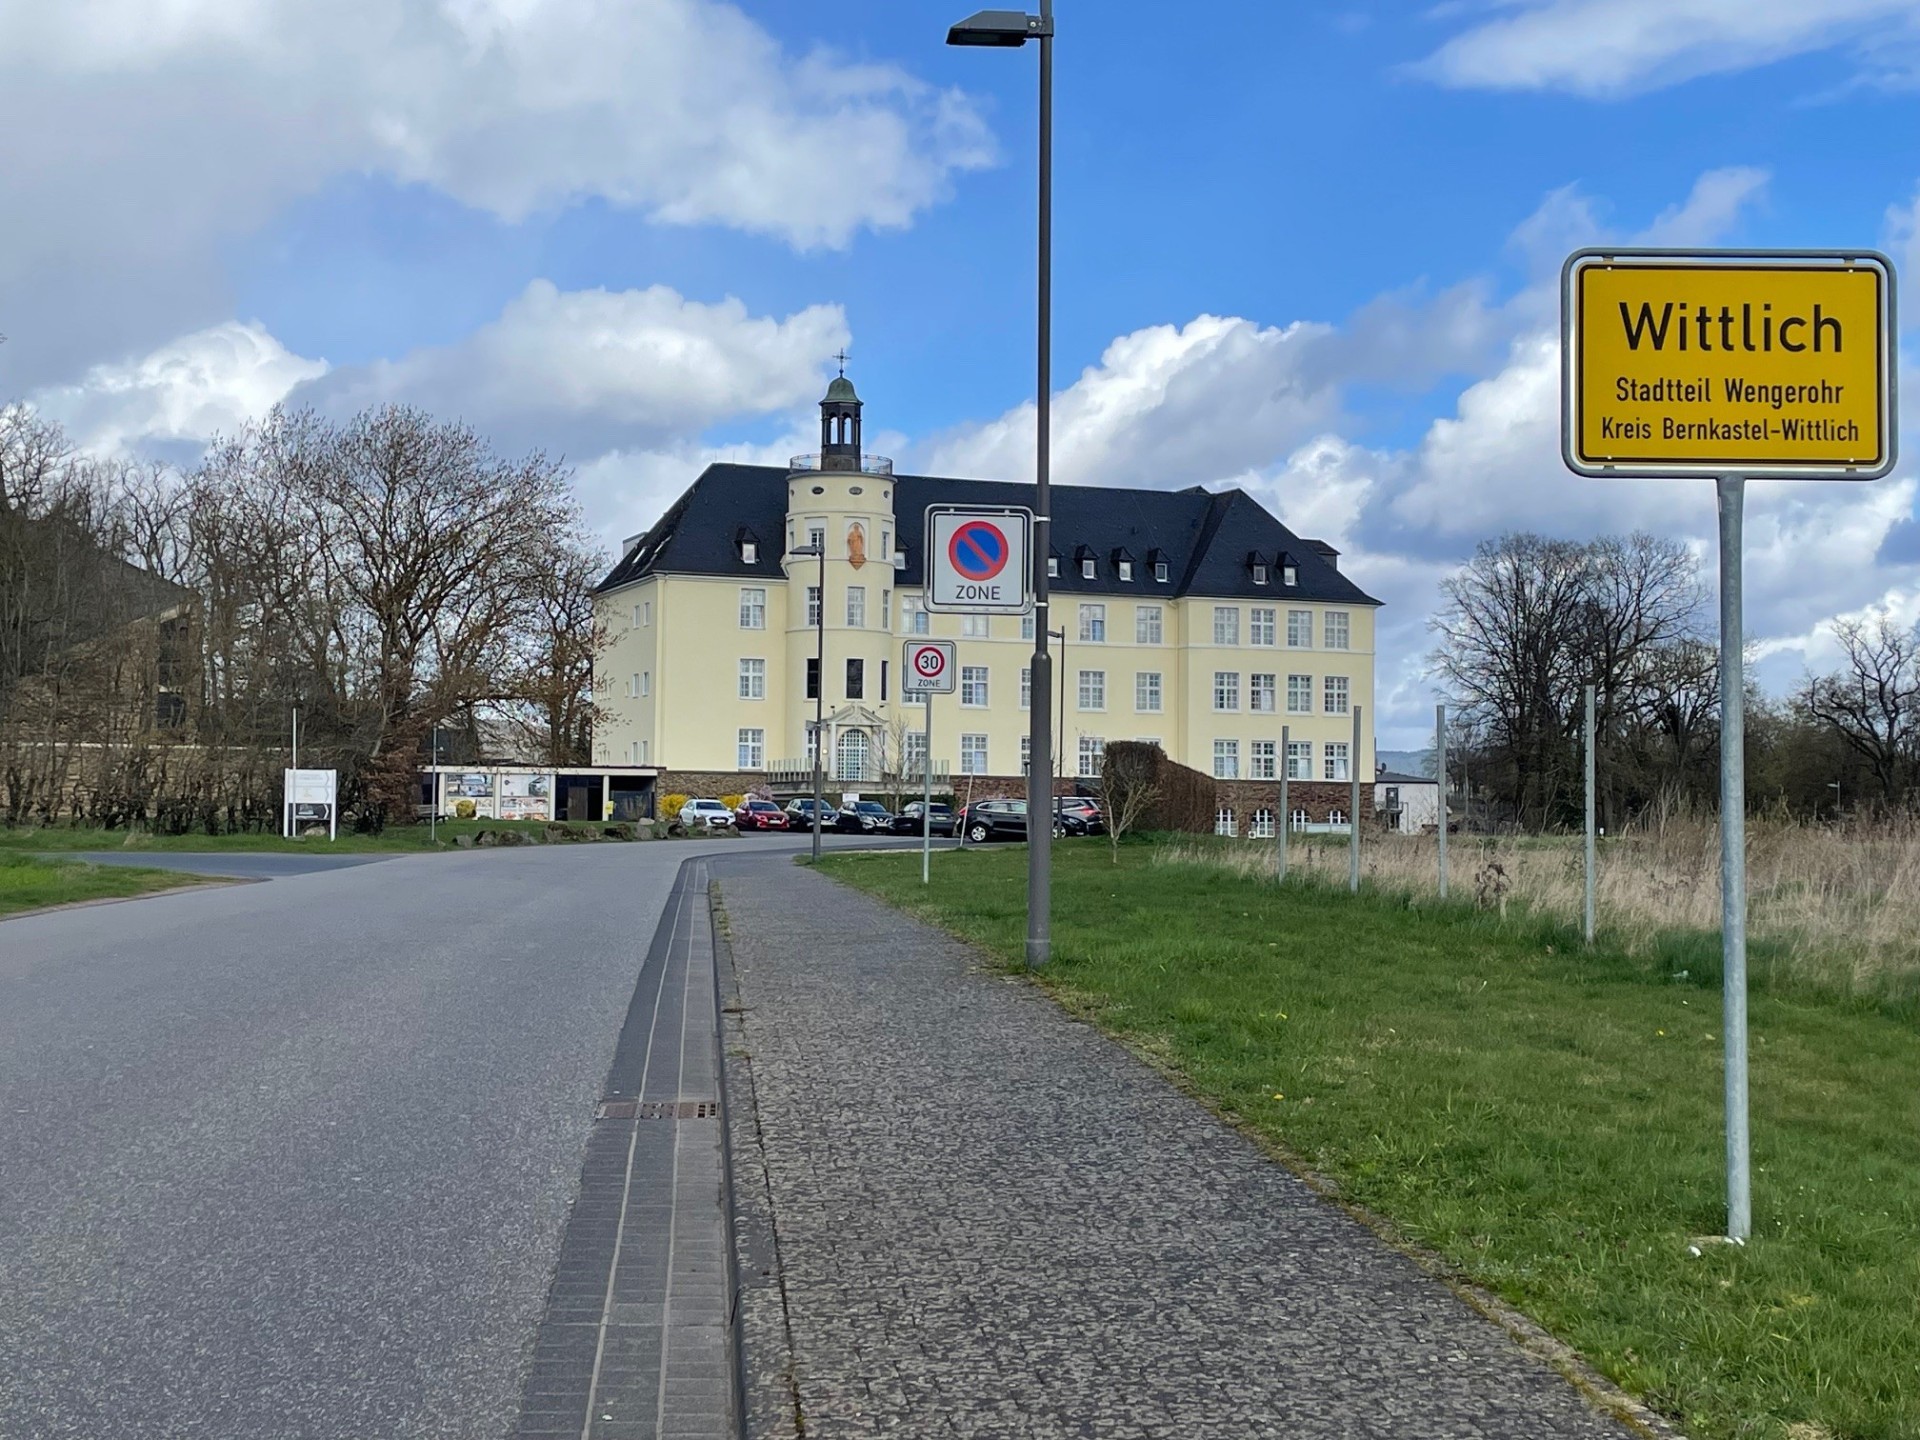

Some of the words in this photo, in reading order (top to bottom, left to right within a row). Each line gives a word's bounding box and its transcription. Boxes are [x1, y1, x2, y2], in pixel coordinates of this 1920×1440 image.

[1619, 302, 1842, 352] Wittlich
[1616, 376, 1711, 403] Stadtteil
[1724, 378, 1844, 410] Wengerohr
[1602, 416, 1652, 439] Kreis
[1663, 417, 1859, 442] Bernkastel-Wittlich
[955, 585, 1001, 600] ZONE
[921, 655, 938, 669] 30
[918, 679, 940, 687] ZONE
